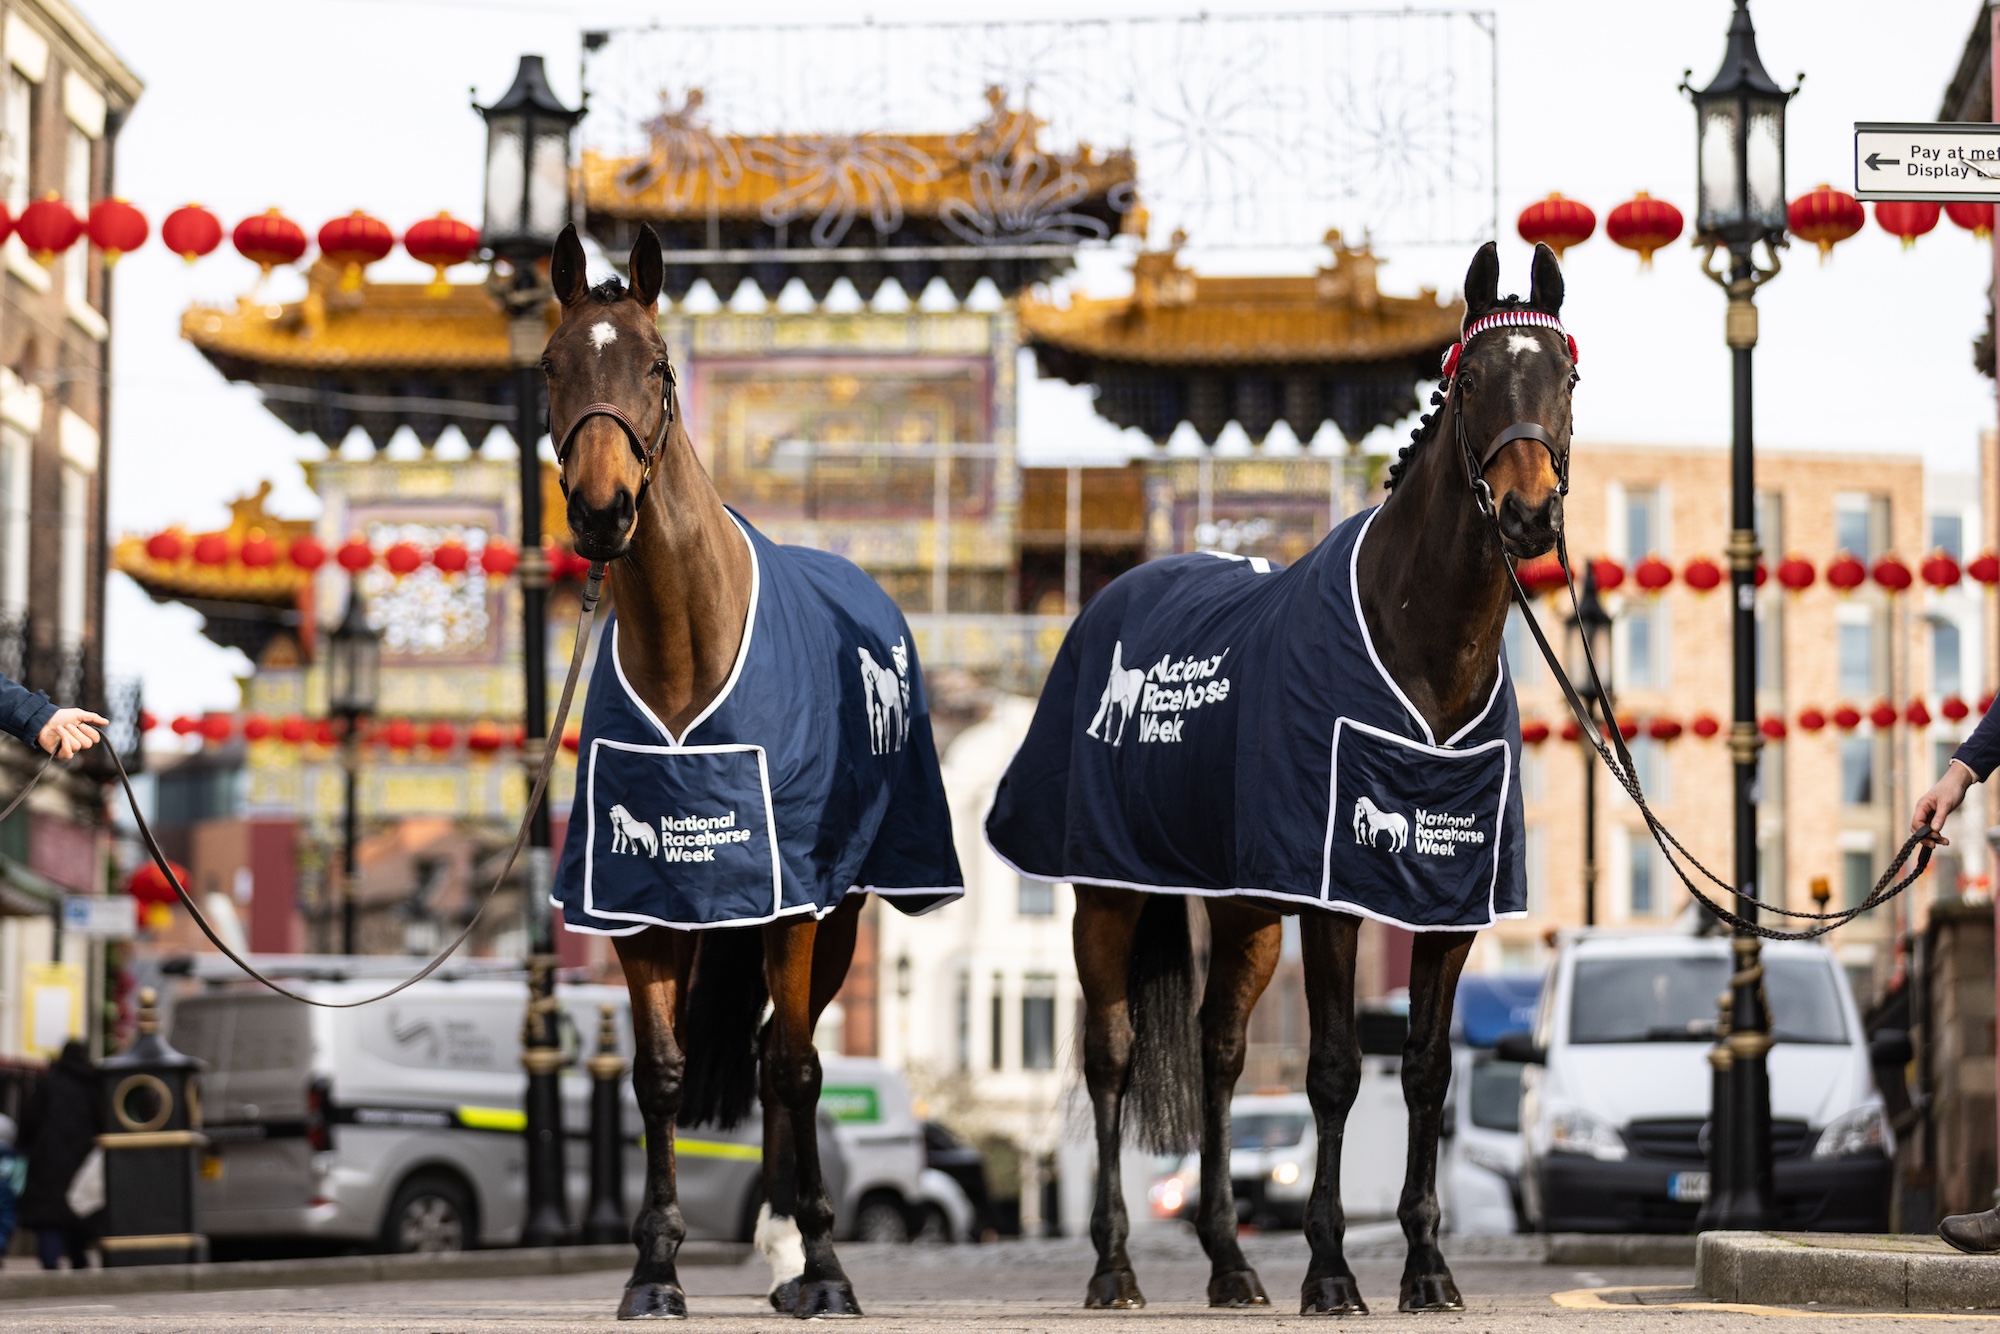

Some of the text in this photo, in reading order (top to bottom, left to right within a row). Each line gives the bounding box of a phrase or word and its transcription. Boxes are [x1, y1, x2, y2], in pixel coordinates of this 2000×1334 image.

[1911, 145, 1941, 161] Pay
[1947, 146, 1964, 160] at
[1907, 163, 1969, 180] Display
[1140, 677, 1231, 712] Racehose
[1138, 713, 1185, 743] Week
[660, 810, 736, 832] National
[1415, 808, 1476, 829] National
[661, 828, 752, 848] Racehorse
[1414, 822, 1485, 844] Racehorse
[663, 846, 716, 863] Week
[1415, 837, 1456, 857] Week
